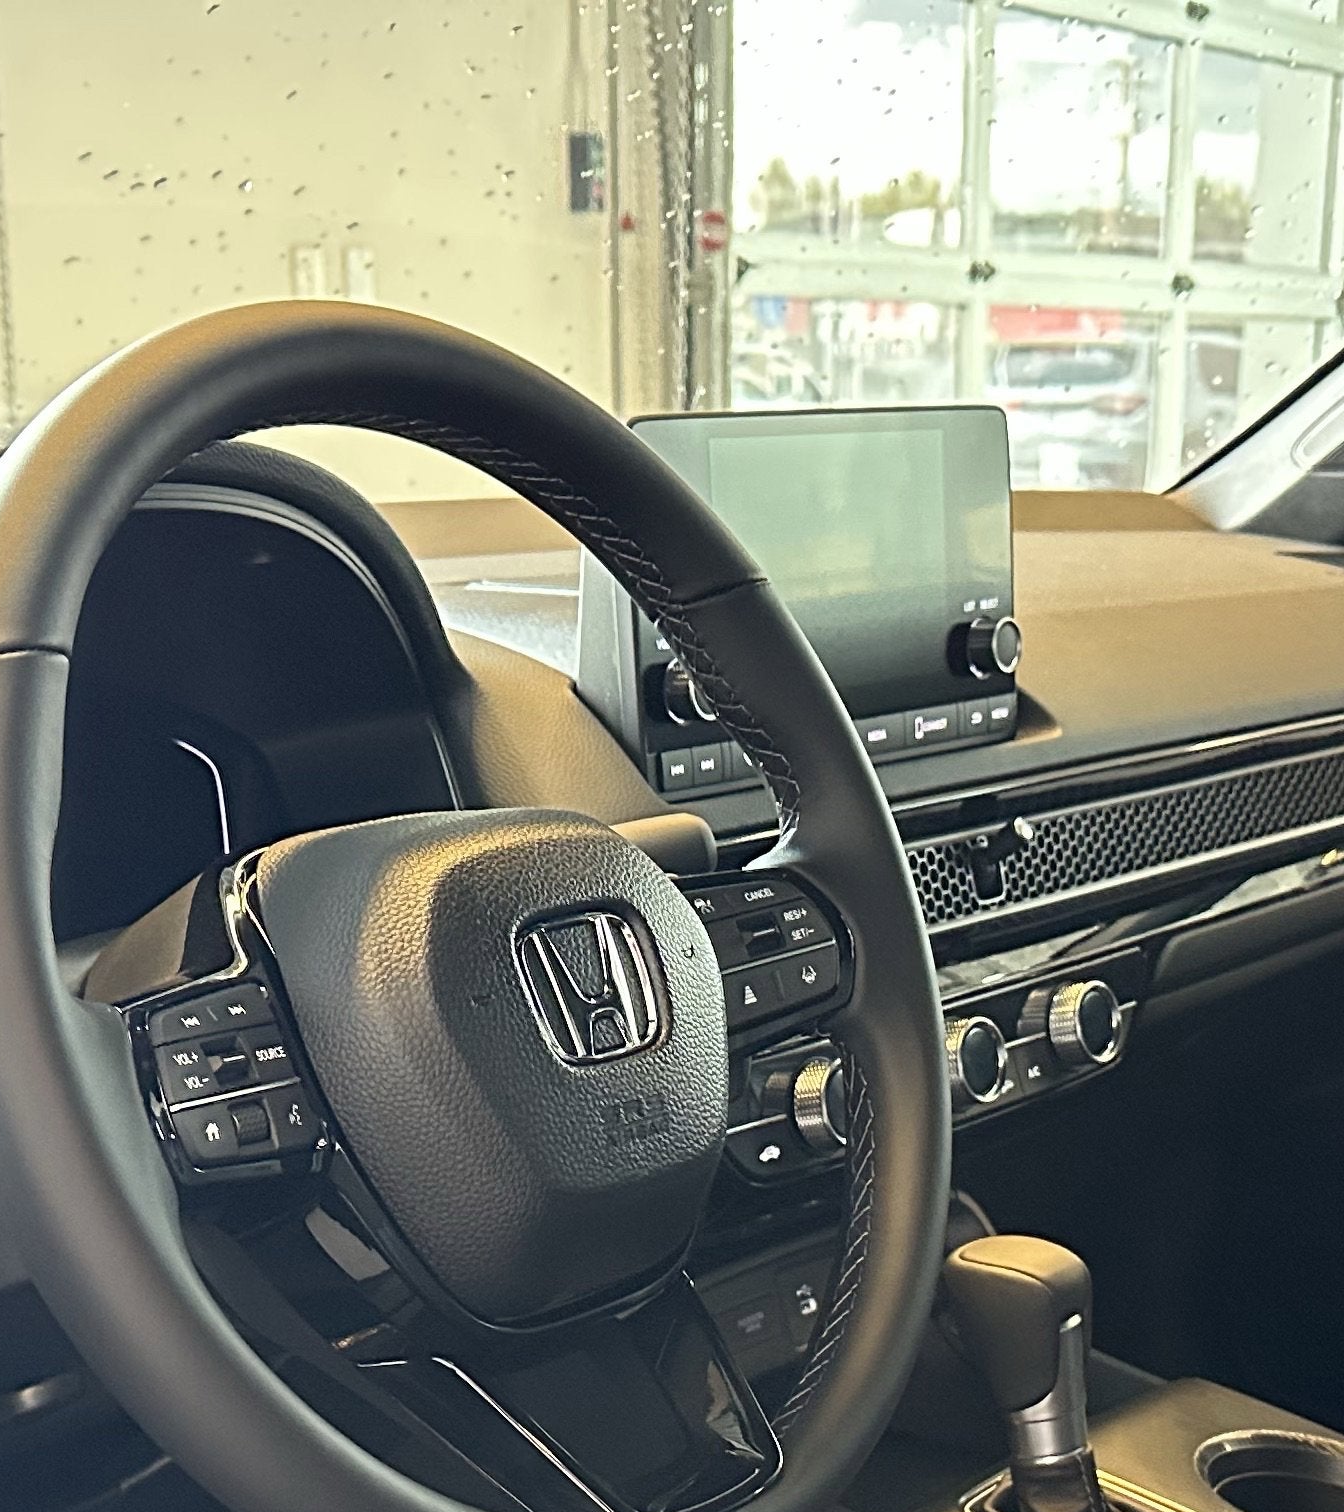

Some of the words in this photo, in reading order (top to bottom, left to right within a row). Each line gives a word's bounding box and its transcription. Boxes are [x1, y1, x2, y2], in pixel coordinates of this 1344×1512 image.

[744, 887, 775, 902] CANCEL
[783, 909, 807, 922] RES/+
[255, 1045, 287, 1062] SOURCE
